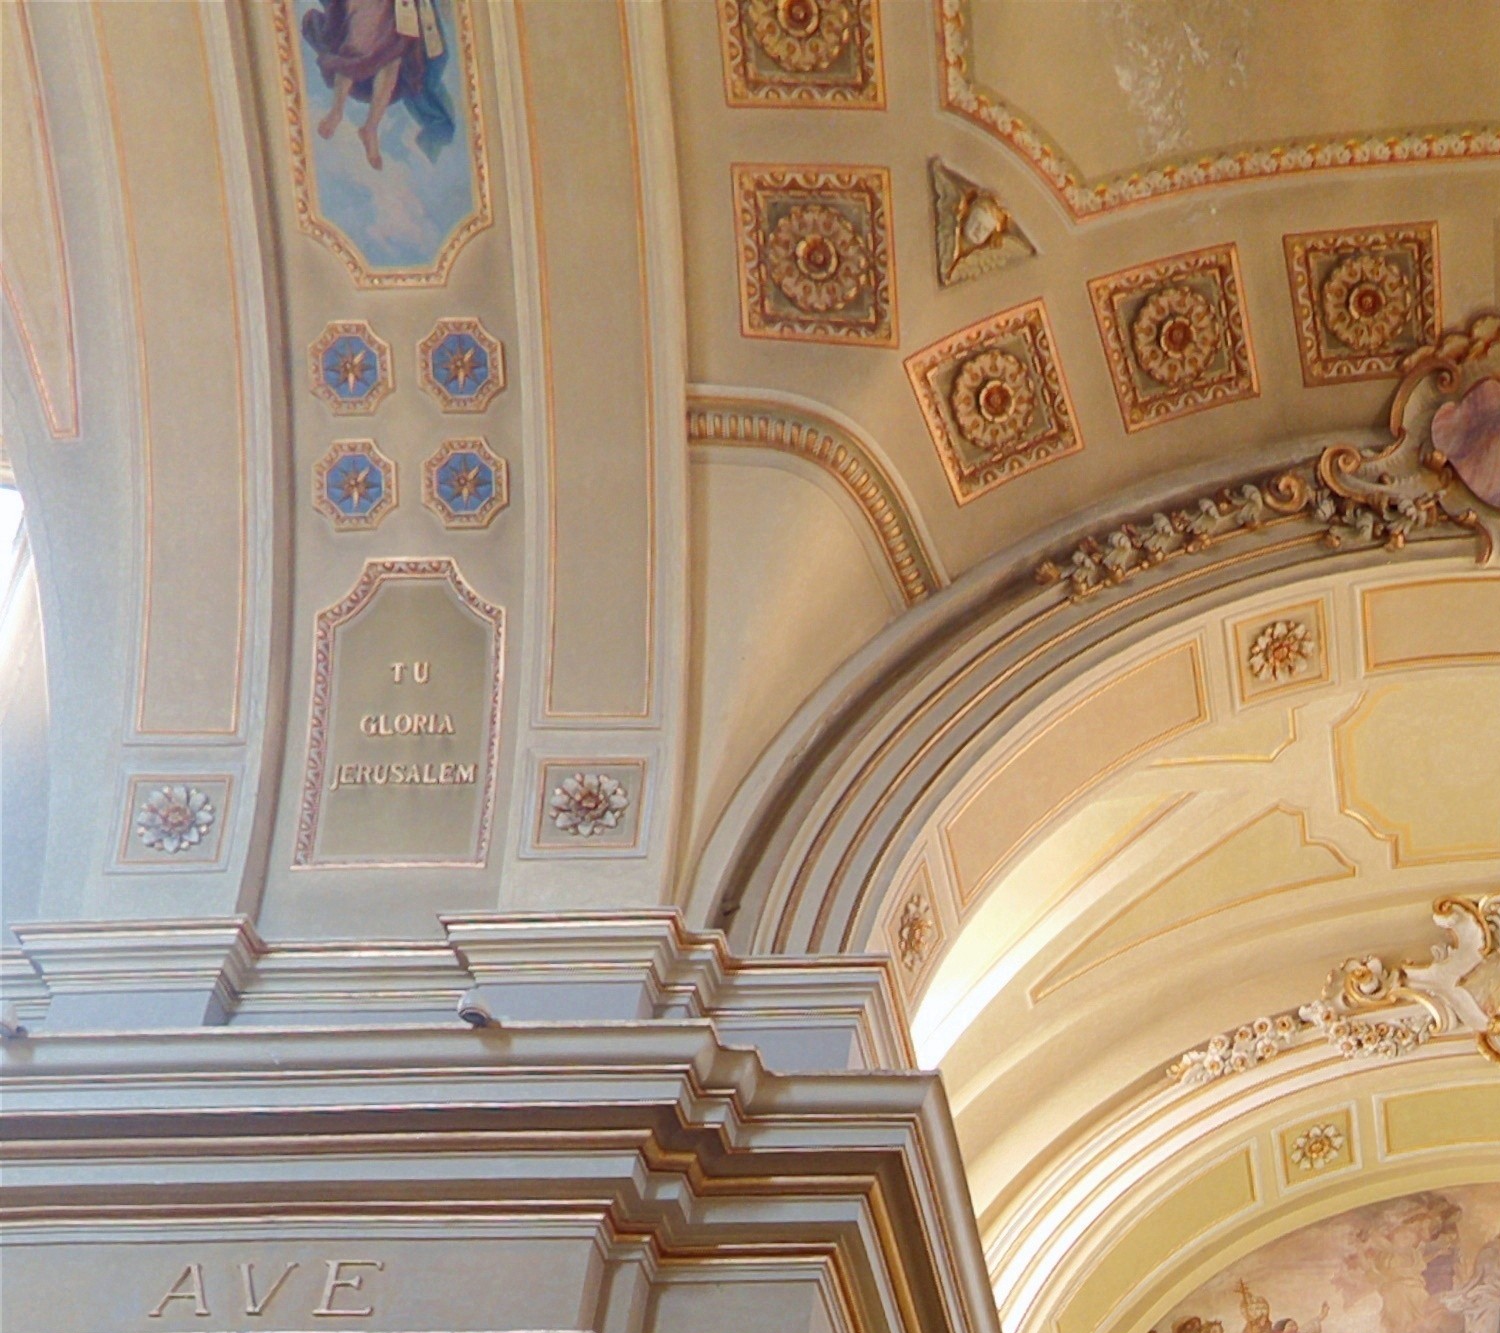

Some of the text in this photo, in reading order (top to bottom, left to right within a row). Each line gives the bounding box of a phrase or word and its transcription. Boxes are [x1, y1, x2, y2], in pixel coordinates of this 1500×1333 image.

[390, 661, 430, 684] TU
[359, 714, 456, 736] GLORIA
[330, 762, 478, 791] JERUSALEM
[148, 1259, 385, 1318] AVE
